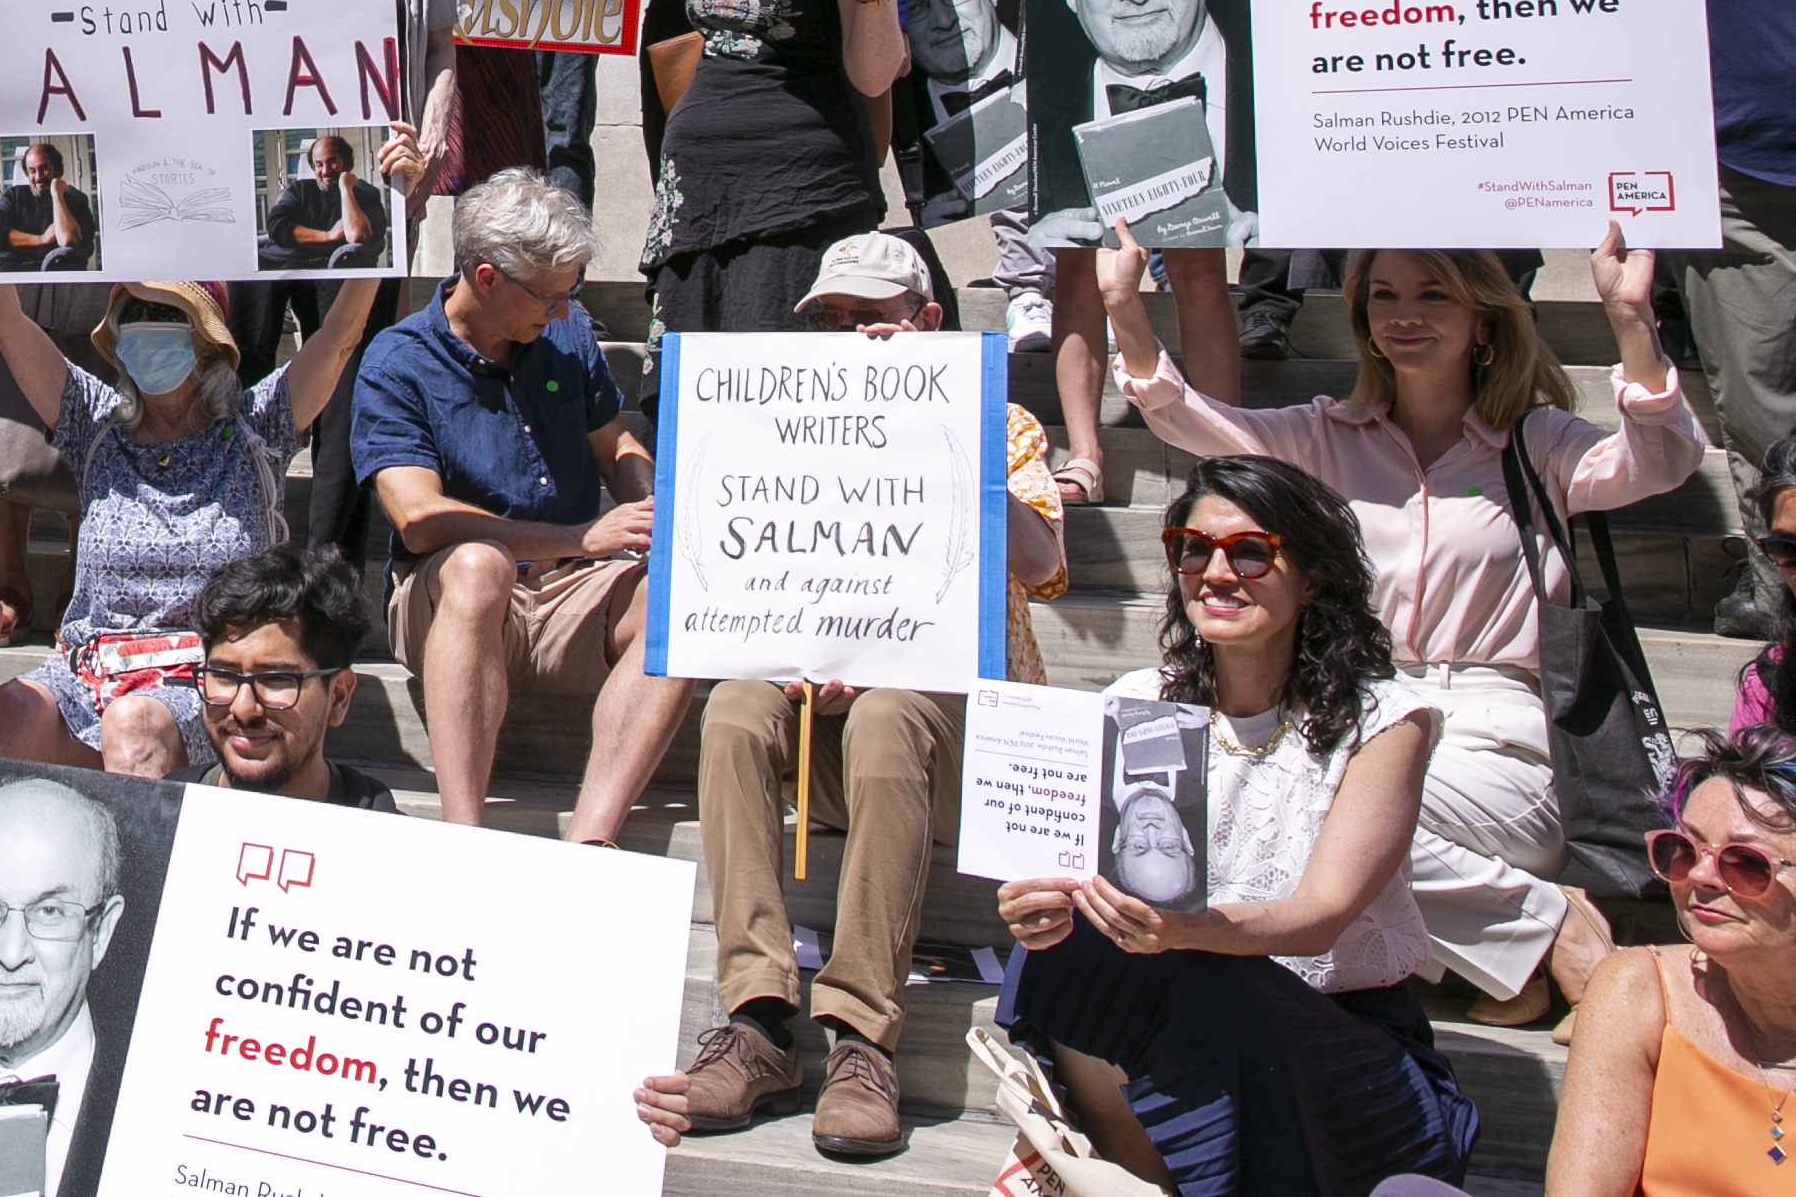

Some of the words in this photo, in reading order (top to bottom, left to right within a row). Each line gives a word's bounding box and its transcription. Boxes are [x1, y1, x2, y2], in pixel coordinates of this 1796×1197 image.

[1312, 49, 1364, 74] are
[1376, 44, 1431, 71] not
[1442, 40, 1526, 68] free.
[1314, 112, 1375, 128] Salman
[1381, 109, 1455, 127] Rushdie,
[1461, 110, 1501, 125] 2012
[1508, 106, 1548, 122] PEN
[1555, 105, 1635, 121] America
[1314, 136, 1366, 152] World
[1372, 137, 1430, 151] Voices
[1436, 132, 1504, 149] Festival
[173, 158, 185, 168] THE
[190, 161, 202, 171] SEA
[152, 173, 195, 185] STORIES
[1478, 181, 1592, 192] #StandWithSalman
[1617, 182, 1638, 190] PEN
[1102, 193, 1146, 216] NINETEEN
[1147, 170, 1206, 201] EIGHTY-FOUR
[1617, 191, 1667, 200] AMERICA
[1505, 197, 1593, 210] @PENamerica
[696, 361, 848, 405] CHILDREN'S
[864, 364, 950, 404] BOOK
[775, 415, 887, 449] WRITERS
[716, 474, 820, 507] STAND
[838, 475, 924, 507] WITH
[719, 516, 924, 560] SALMAN
[745, 570, 788, 592] and
[801, 574, 894, 604] against
[684, 606, 804, 643] attempted
[815, 607, 936, 642] murder
[1009, 763, 1038, 779] free.
[1042, 768, 1062, 779] not
[1067, 772, 1087, 782] are
[976, 778, 993, 787] we
[996, 781, 1024, 796] then
[984, 799, 1005, 808] our
[1028, 784, 1086, 807] freedom,
[1008, 803, 1021, 815] of
[1025, 805, 1085, 823] confident
[1006, 821, 1026, 833] not
[1030, 826, 1050, 836] are
[1054, 830, 1071, 839] we
[1074, 834, 1084, 846] If
[225, 906, 259, 942] If
[268, 923, 320, 954] we
[331, 932, 397, 966] are
[409, 946, 478, 982] not
[214, 971, 408, 1030] confident
[420, 1007, 466, 1039] of
[474, 1019, 548, 1055] our
[204, 1018, 390, 1092] freedom,
[403, 1059, 499, 1108] then
[511, 1086, 573, 1124] we
[189, 1087, 256, 1124] are
[267, 1102, 335, 1140] not
[349, 1108, 448, 1163] free.
[1037, 1161, 1065, 1196] PEN
